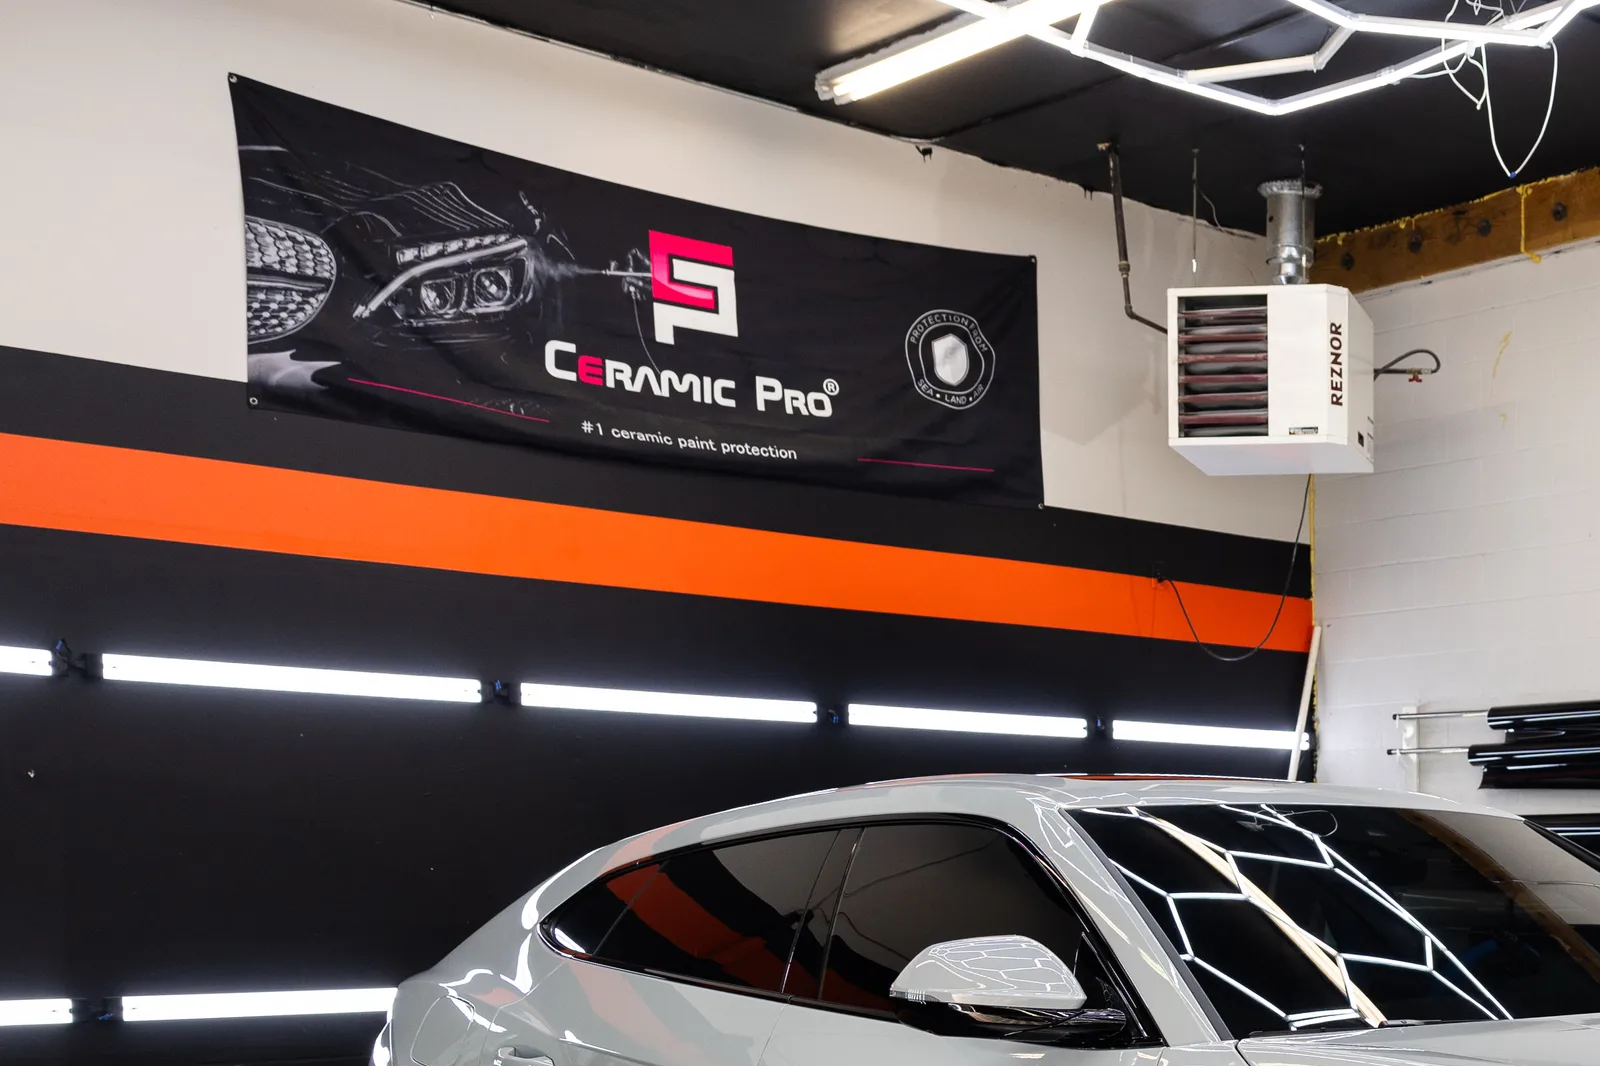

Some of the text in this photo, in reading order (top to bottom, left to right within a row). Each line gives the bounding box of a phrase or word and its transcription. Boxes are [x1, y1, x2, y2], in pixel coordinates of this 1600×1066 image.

[909, 314, 988, 352] PROTECTION FROM
[544, 339, 737, 408] CERAMIC
[1329, 322, 1343, 407] REZNOR
[917, 378, 934, 397] SEA
[944, 393, 967, 405] LAND
[581, 420, 798, 460] #1 ceramic paint protection
